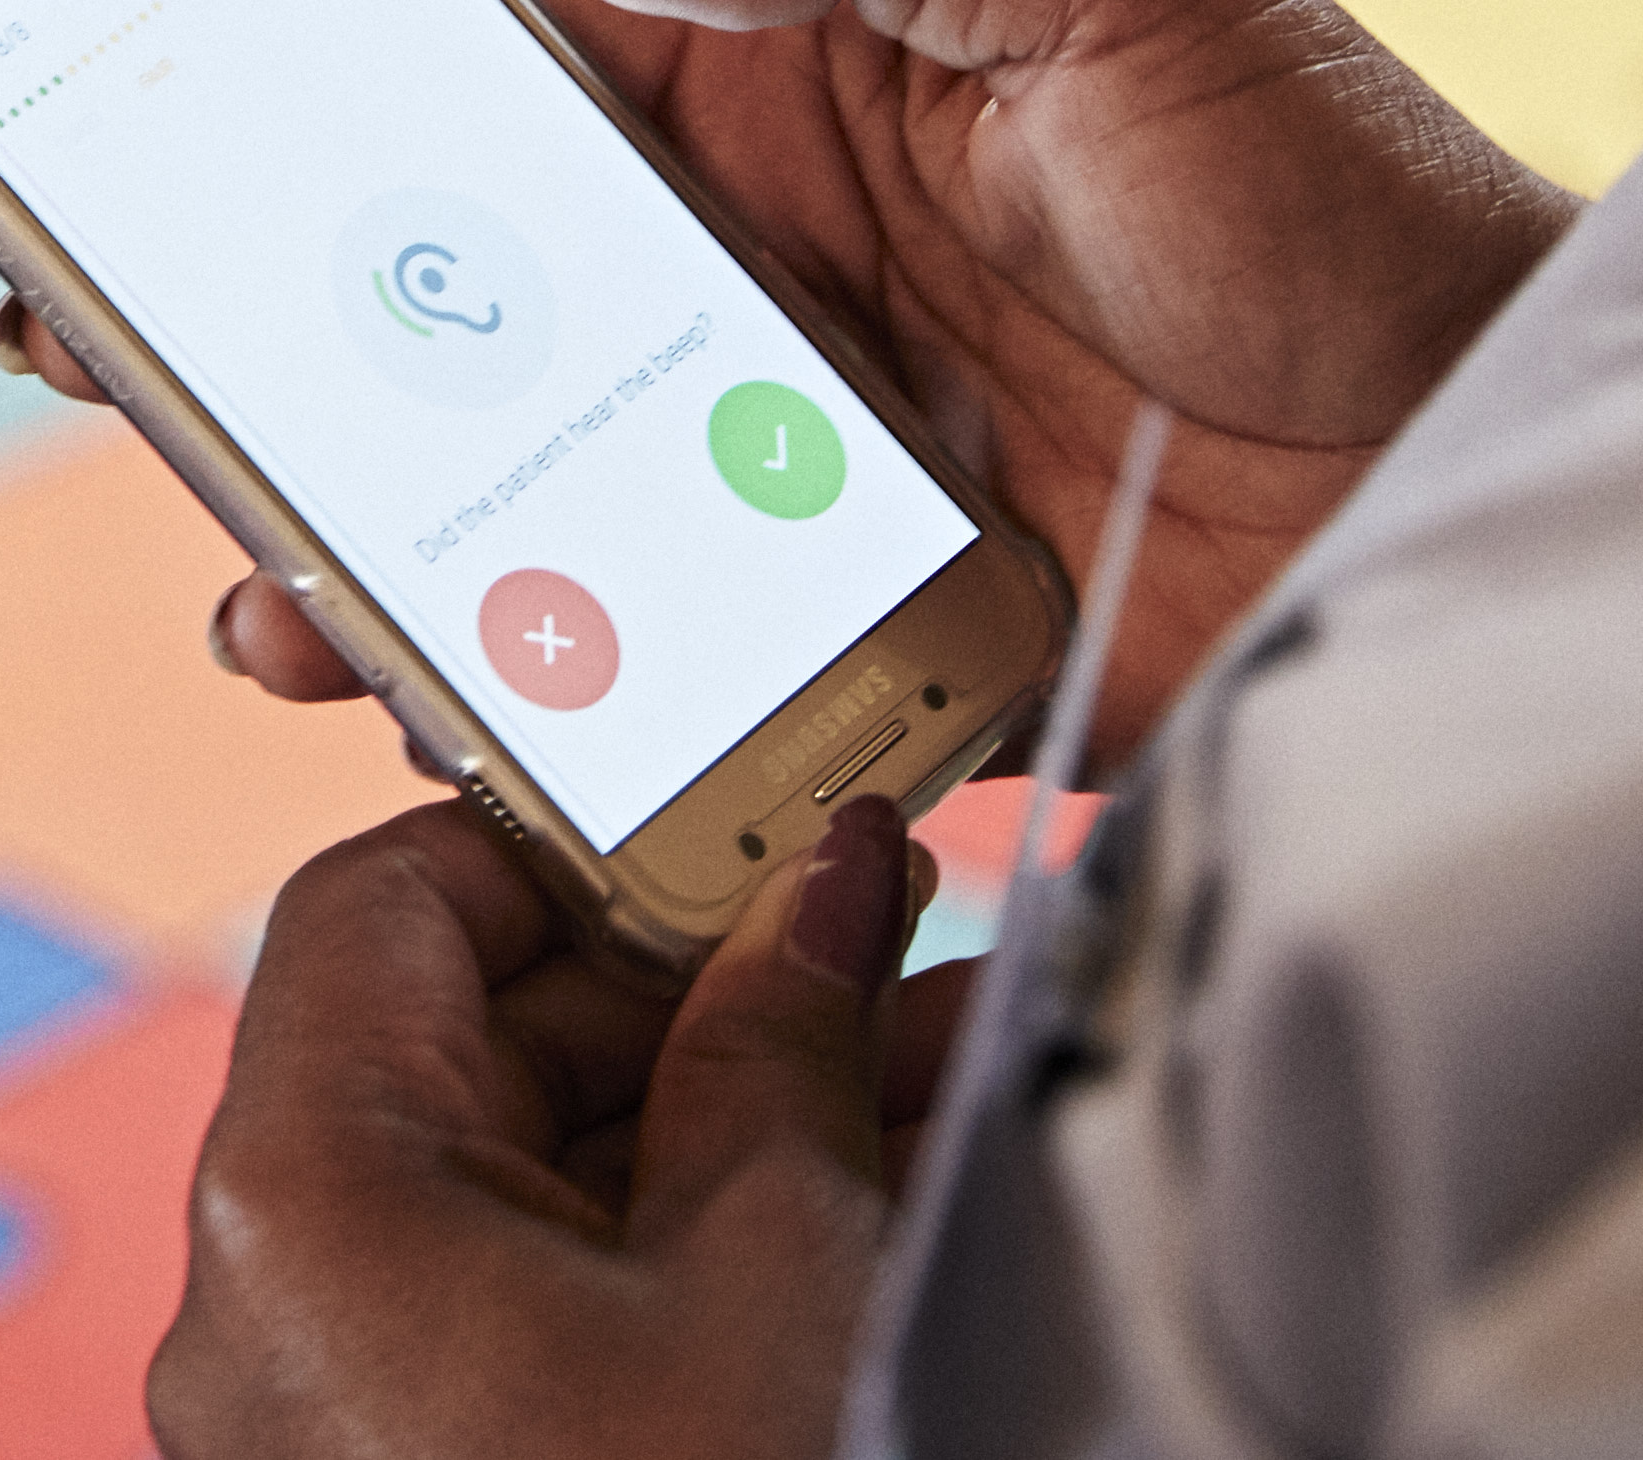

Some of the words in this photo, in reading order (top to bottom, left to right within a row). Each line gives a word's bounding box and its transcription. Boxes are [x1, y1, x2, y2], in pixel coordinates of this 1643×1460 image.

[413, 521, 460, 564] Did
[455, 496, 498, 532] the
[494, 434, 573, 510] patient
[562, 395, 619, 443] hear
[615, 366, 657, 403] the
[644, 310, 712, 374] beep?
[762, 664, 893, 784] SAMSUNG
